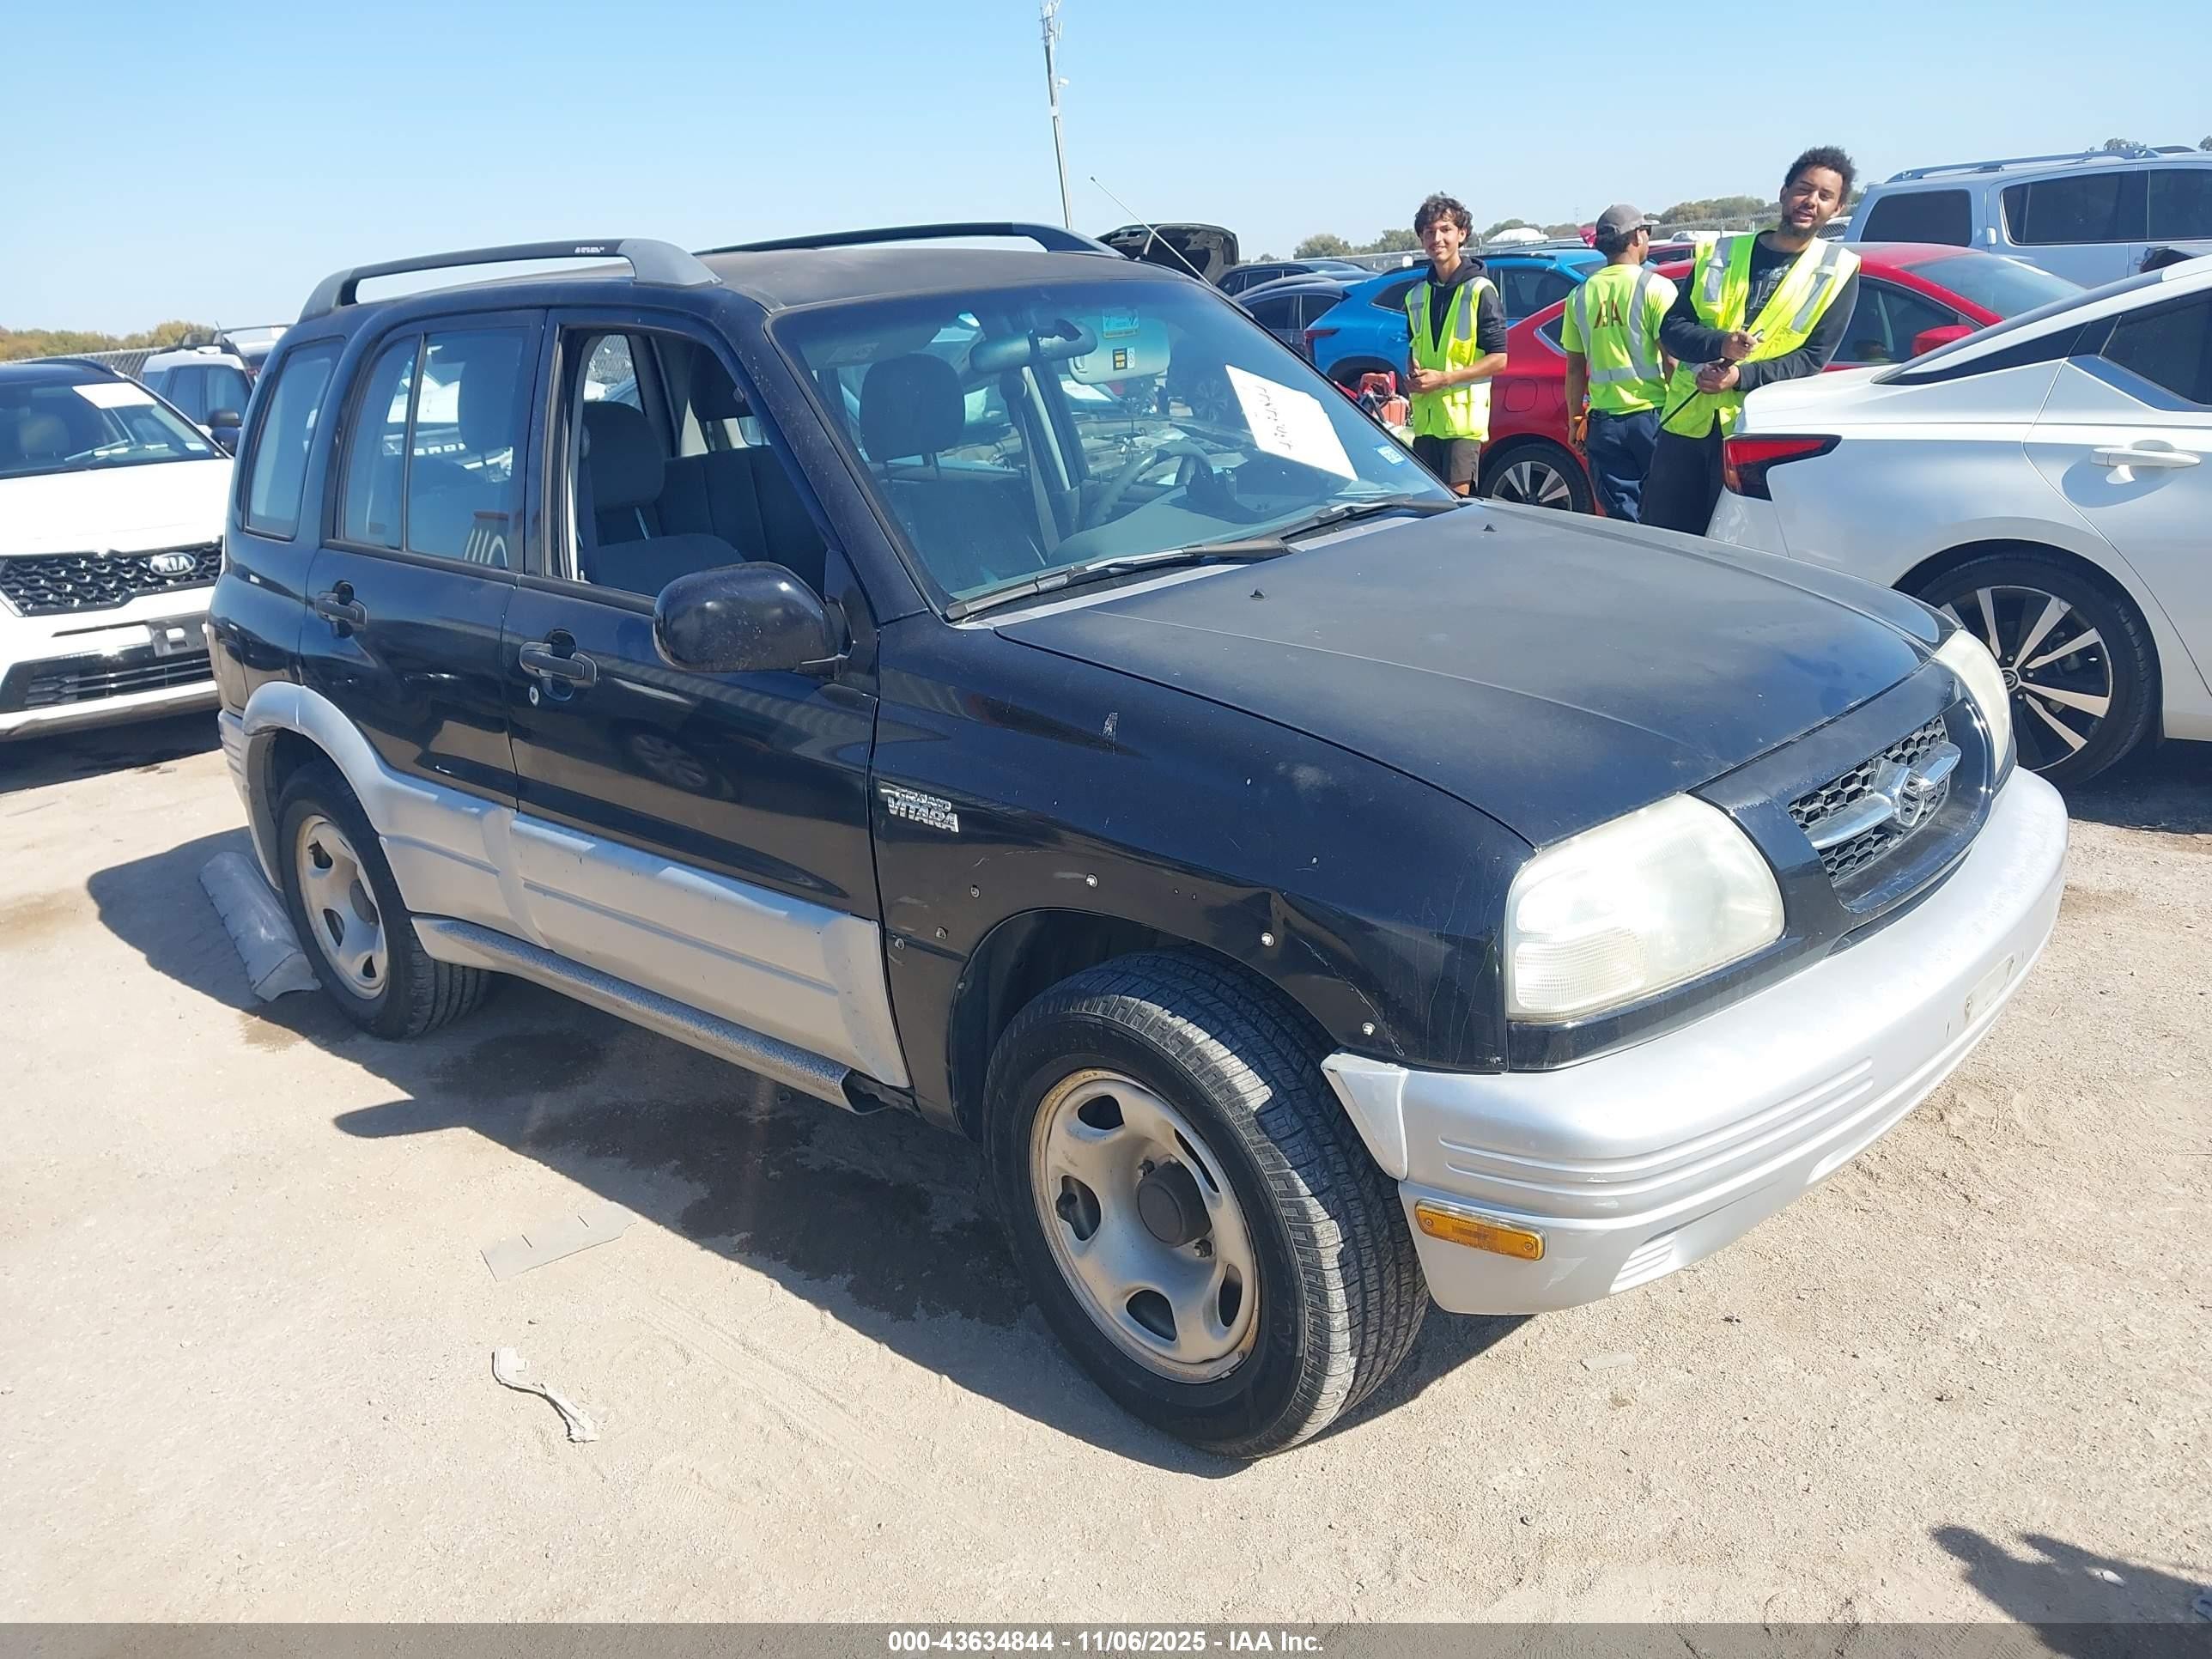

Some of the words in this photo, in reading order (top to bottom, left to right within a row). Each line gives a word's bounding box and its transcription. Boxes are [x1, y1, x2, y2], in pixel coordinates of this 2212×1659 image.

[156, 556, 191, 572] KIA
[895, 788, 951, 812] GRAND
[887, 795, 959, 833] VITARA
